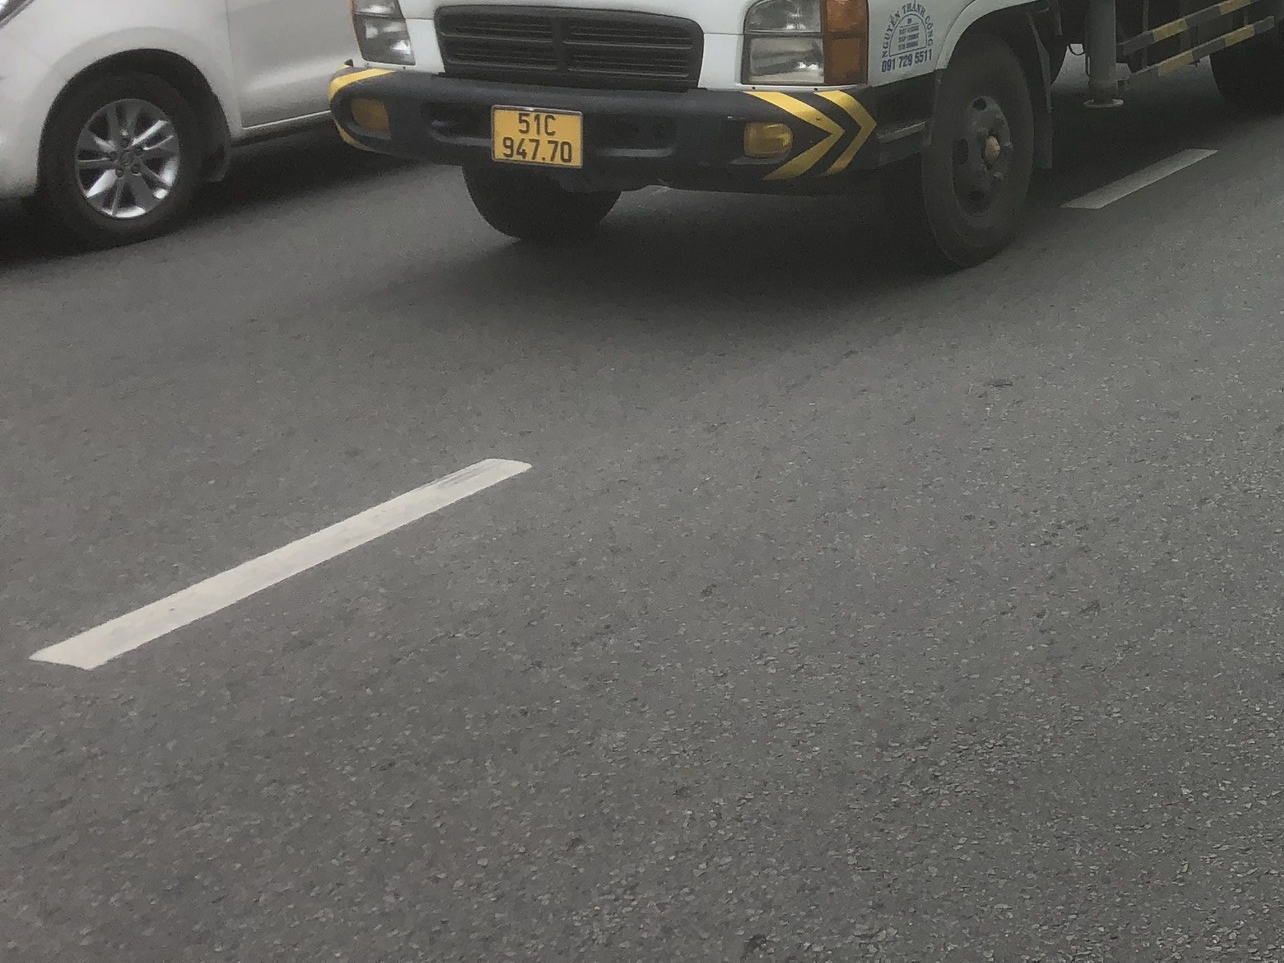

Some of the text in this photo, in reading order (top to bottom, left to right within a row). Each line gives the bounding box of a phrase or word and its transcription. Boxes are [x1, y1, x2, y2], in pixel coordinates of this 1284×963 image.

[881, 48, 933, 73] 091 729 5511
[518, 112, 556, 136] 51C
[502, 136, 573, 163] 947.70
